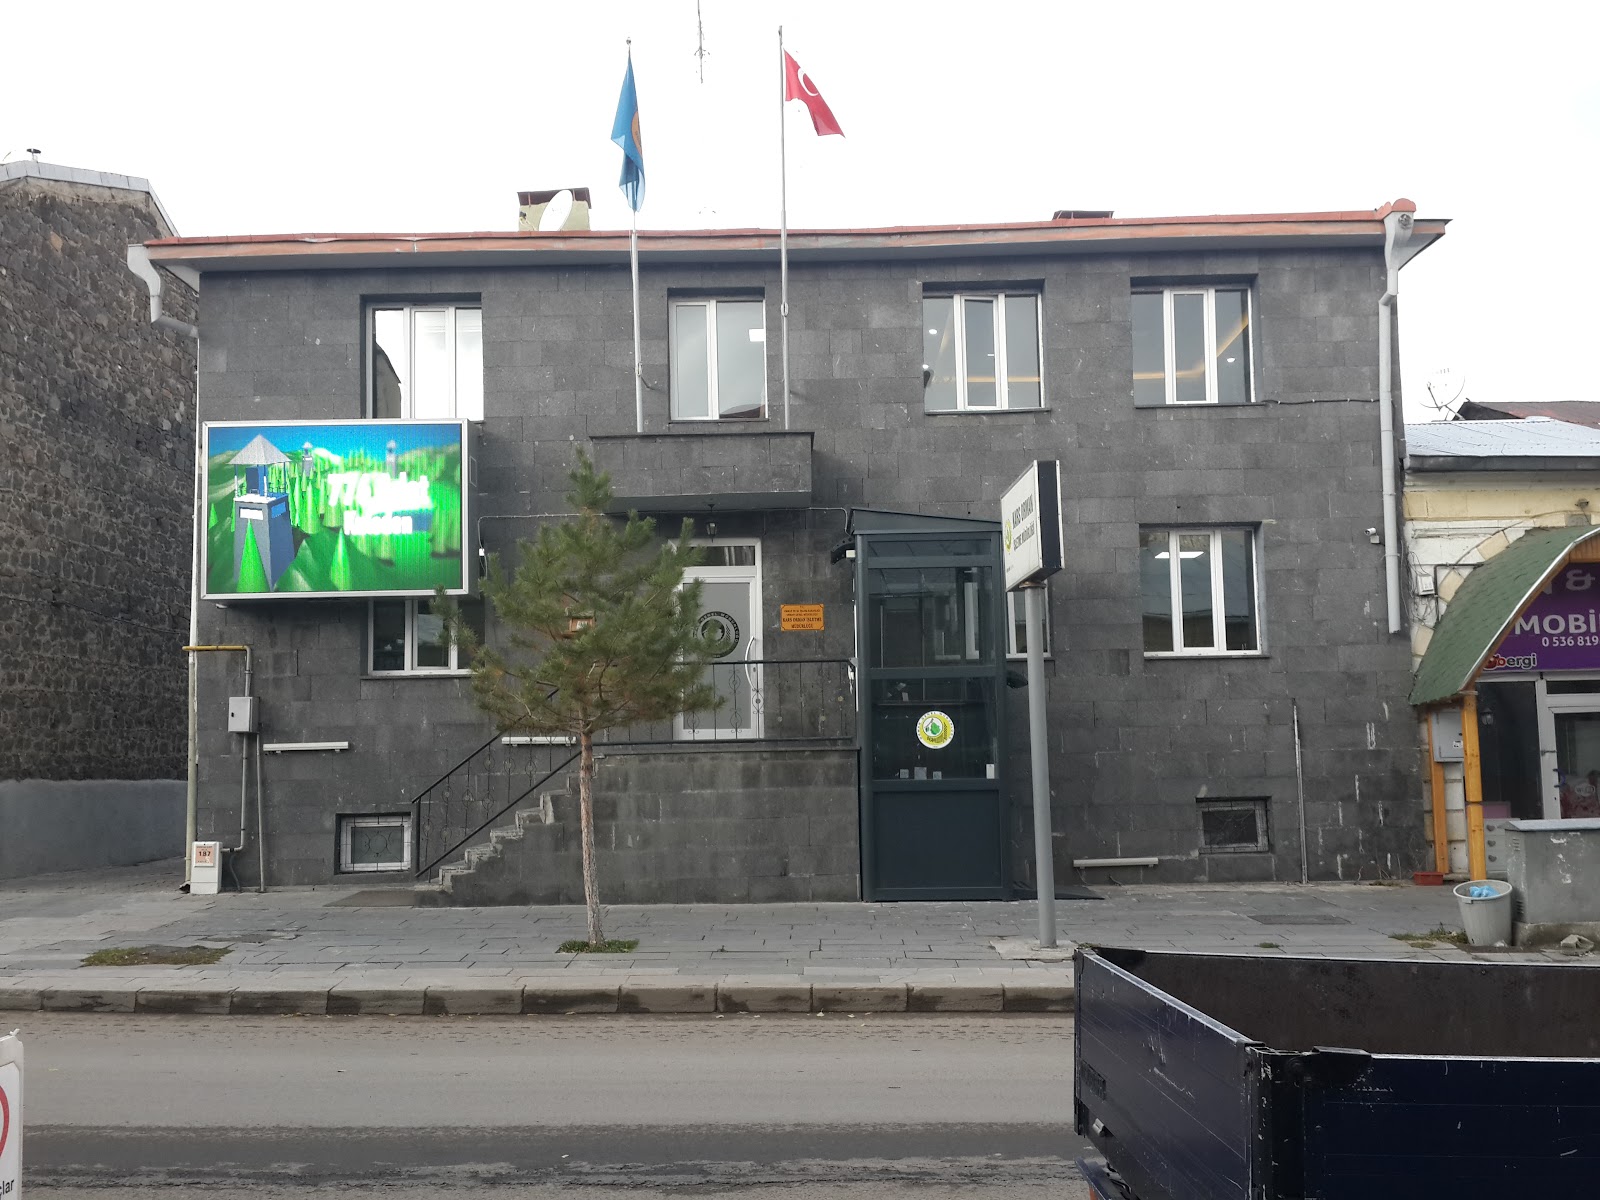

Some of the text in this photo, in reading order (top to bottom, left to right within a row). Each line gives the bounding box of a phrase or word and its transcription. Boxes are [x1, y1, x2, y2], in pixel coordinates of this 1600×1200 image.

[1515, 608, 1600, 635] MOBİ
[1541, 635, 1599, 647] 0 536 819
